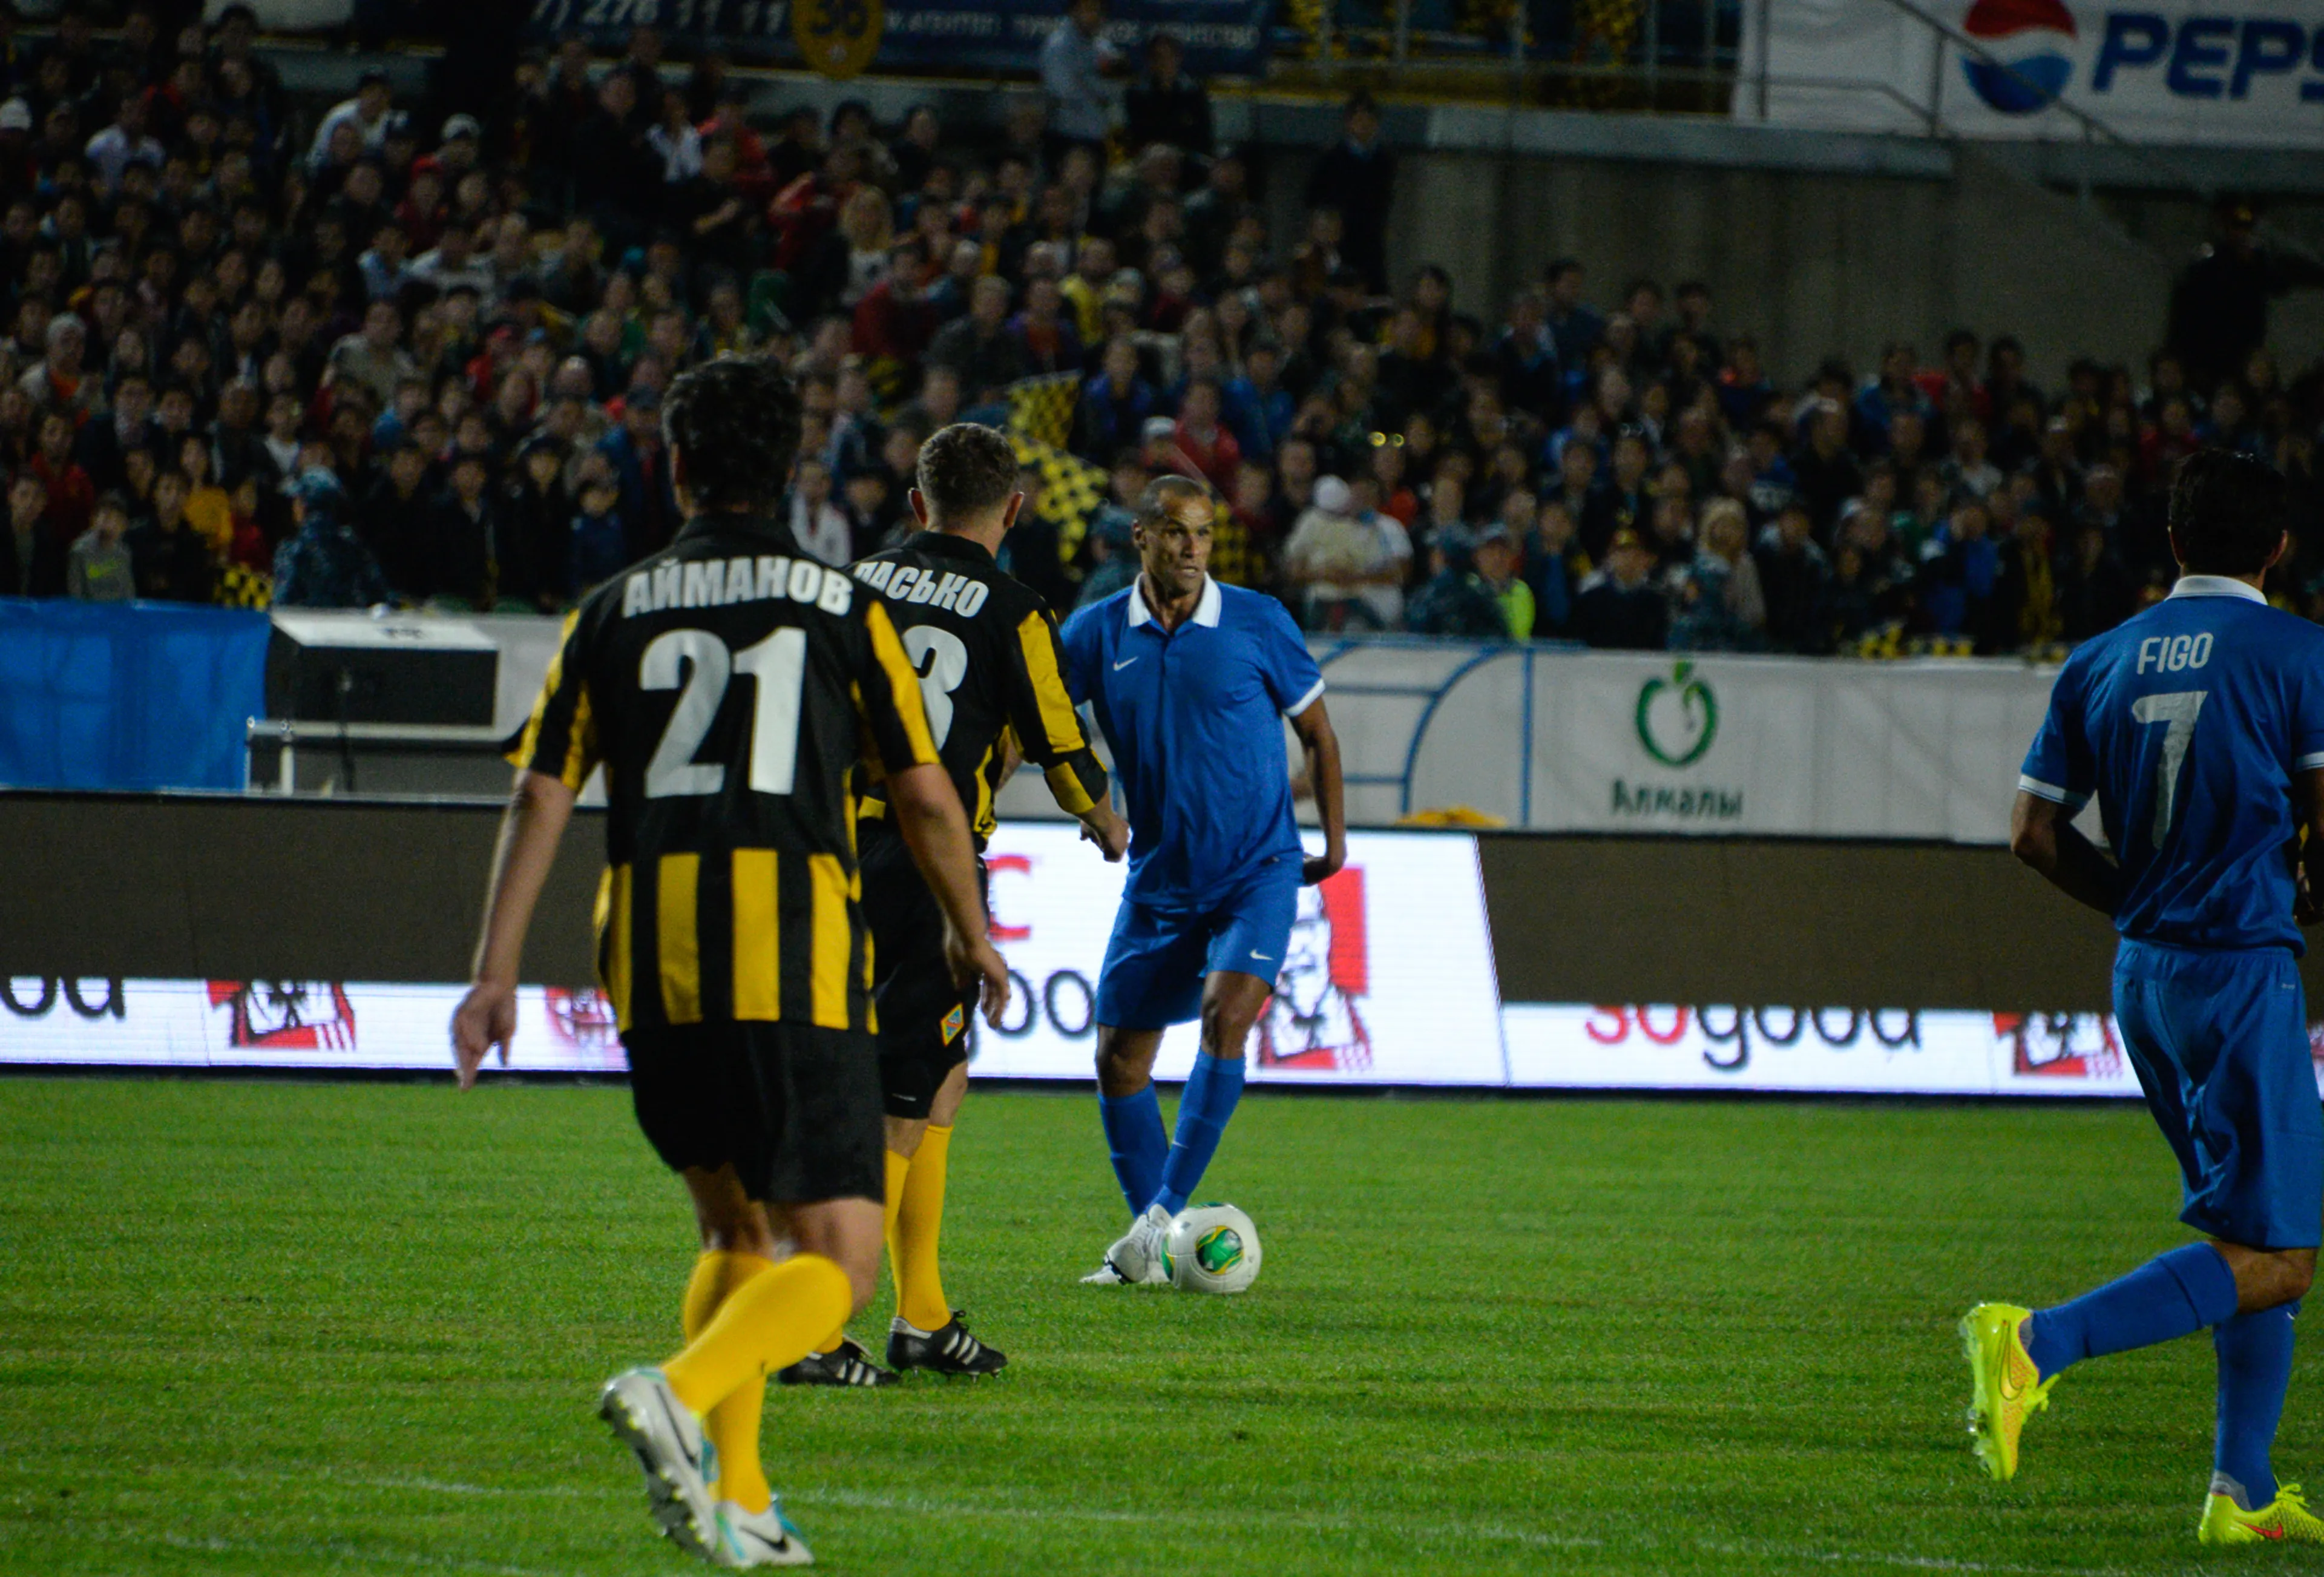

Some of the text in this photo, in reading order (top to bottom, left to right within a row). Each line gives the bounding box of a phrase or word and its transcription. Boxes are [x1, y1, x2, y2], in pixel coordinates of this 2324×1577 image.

[622, 555, 853, 618] АЙМАНОВ
[2136, 632, 2214, 675] FIGO
[639, 625, 807, 799] 21
[2132, 690, 2208, 851] 7
